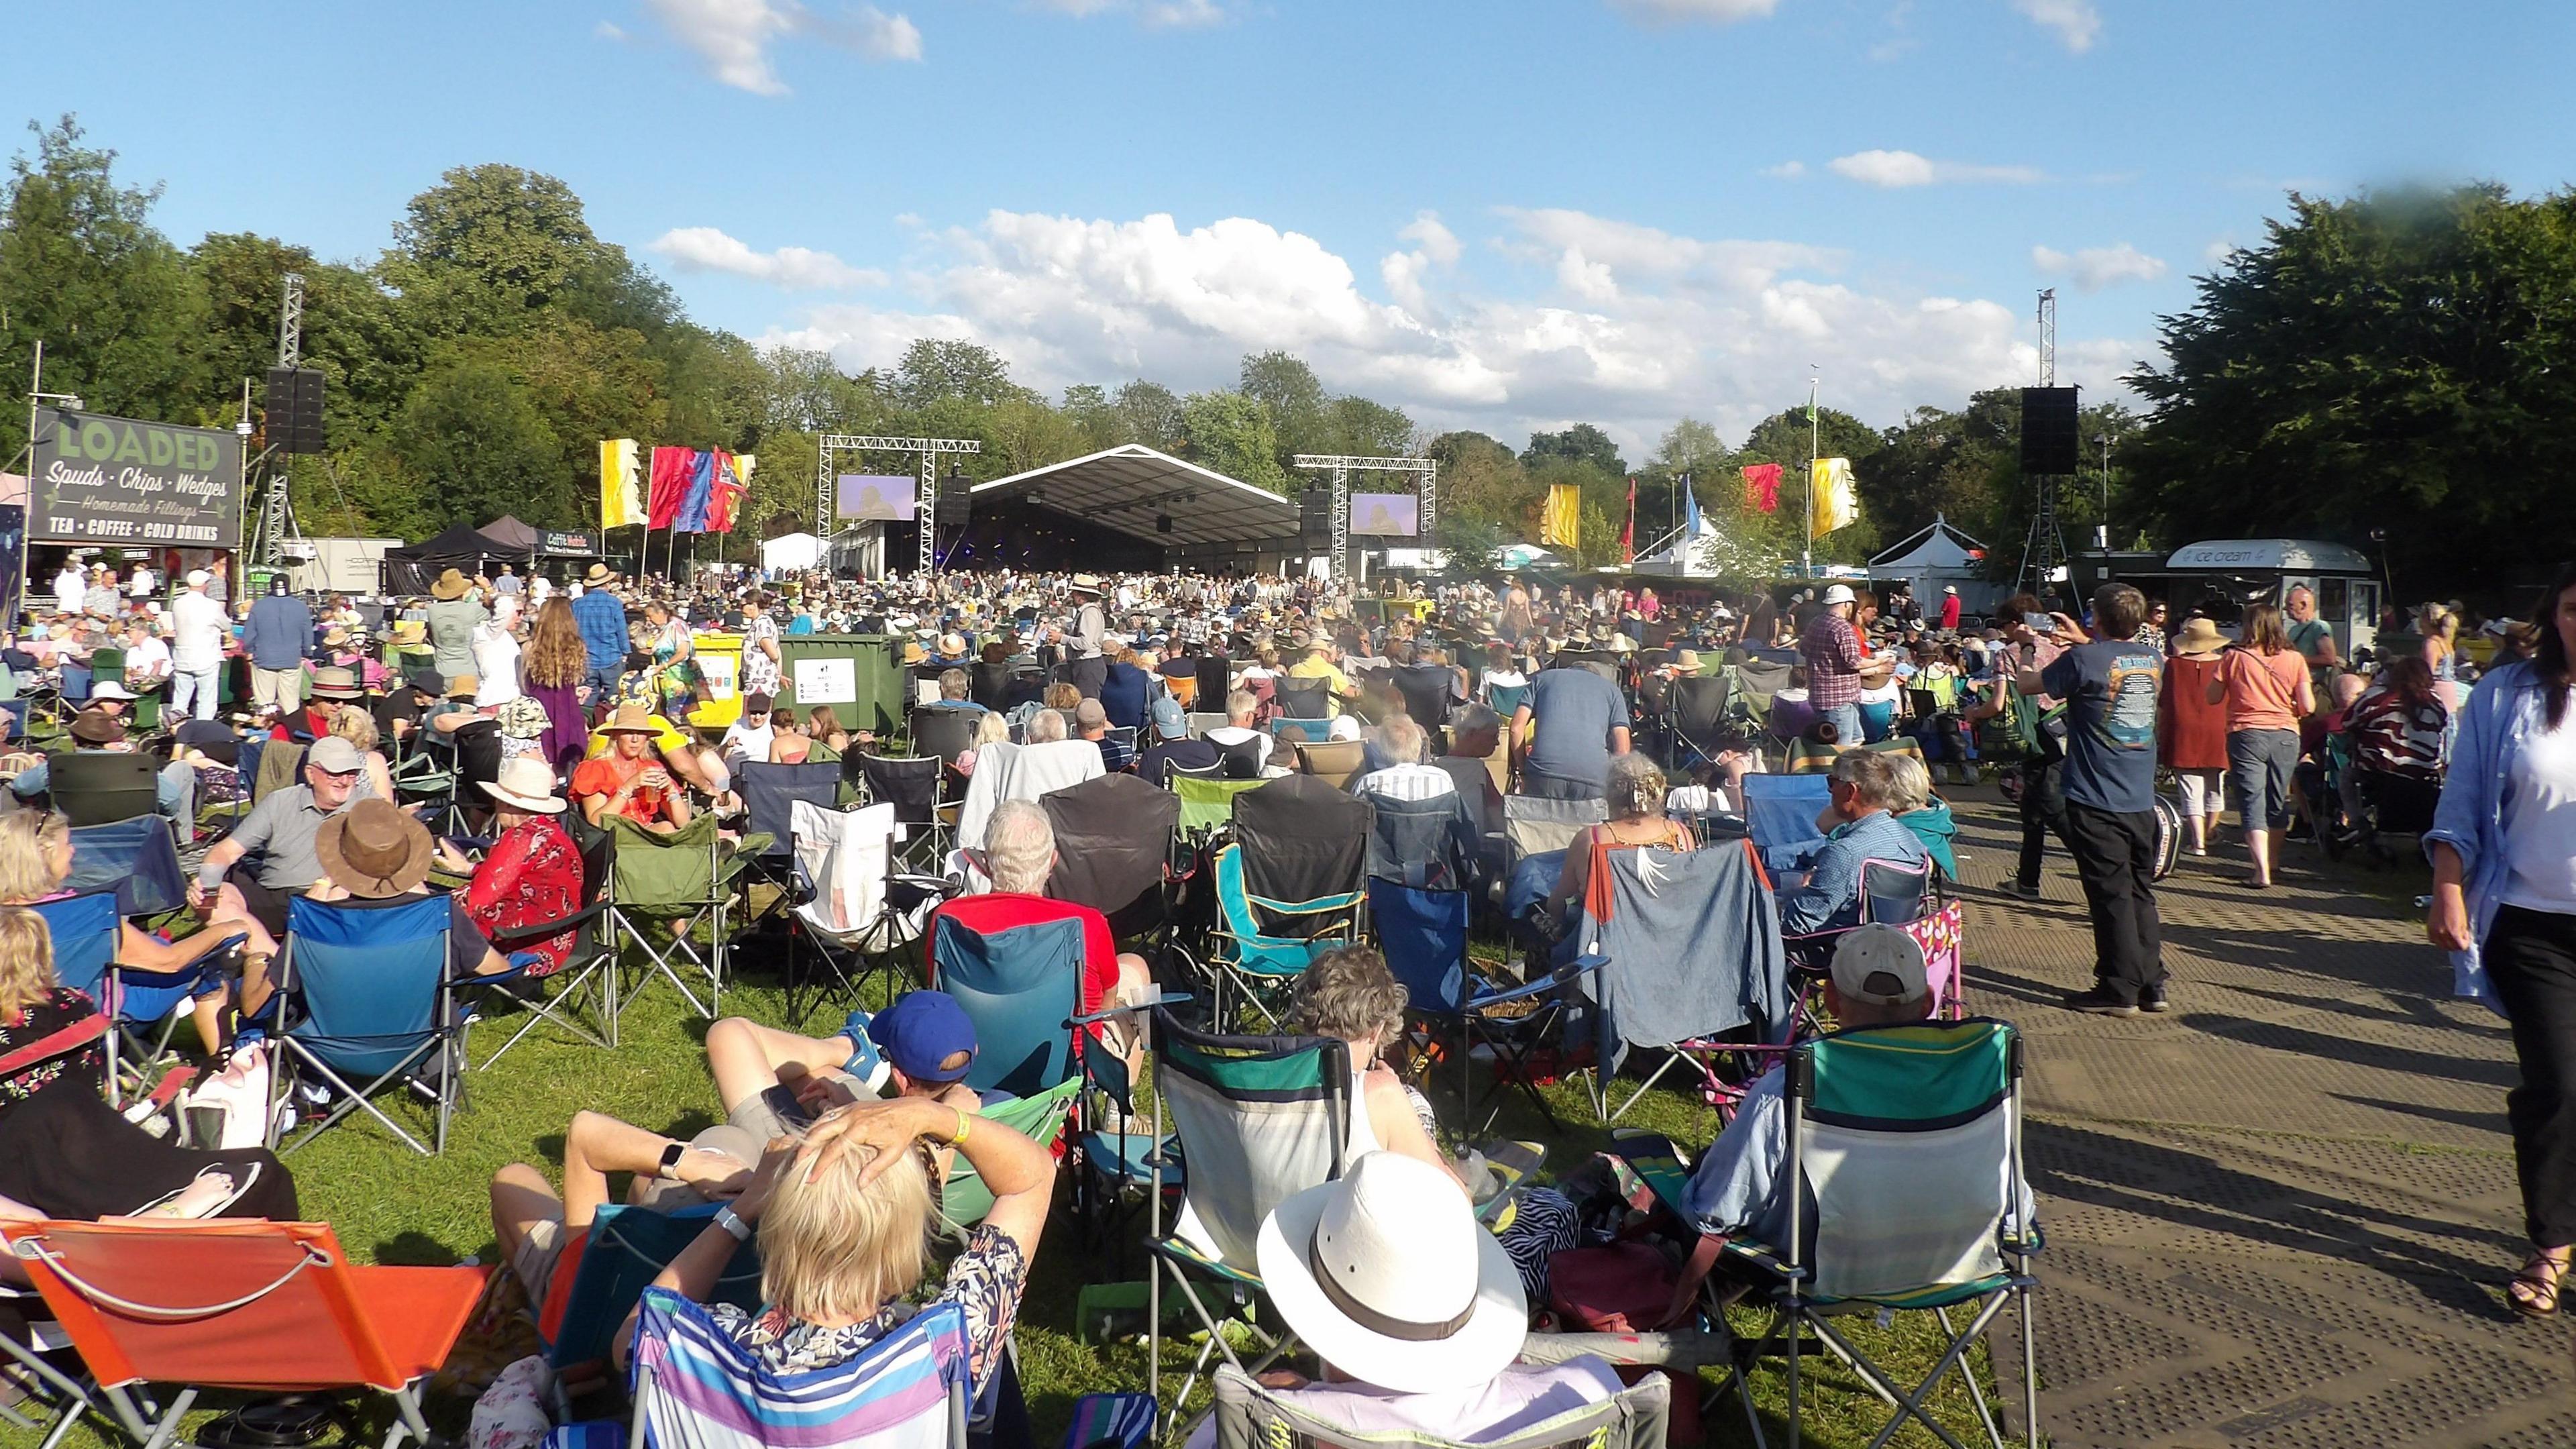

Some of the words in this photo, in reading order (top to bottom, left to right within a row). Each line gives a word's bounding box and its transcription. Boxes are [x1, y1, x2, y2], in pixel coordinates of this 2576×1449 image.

[58, 421, 219, 471] LOADED
[46, 460, 105, 488] Spuds
[119, 467, 164, 496] Chips
[175, 473, 227, 505] Wedges
[81, 494, 150, 515] Homemade
[154, 500, 197, 523] Fillings
[50, 517, 74, 533] TEA
[87, 519, 133, 537] COFFEE
[144, 523, 174, 539] COLD
[176, 525, 218, 541] DRINKS
[2194, 552, 2212, 562] ice
[2214, 551, 2251, 562] cream
